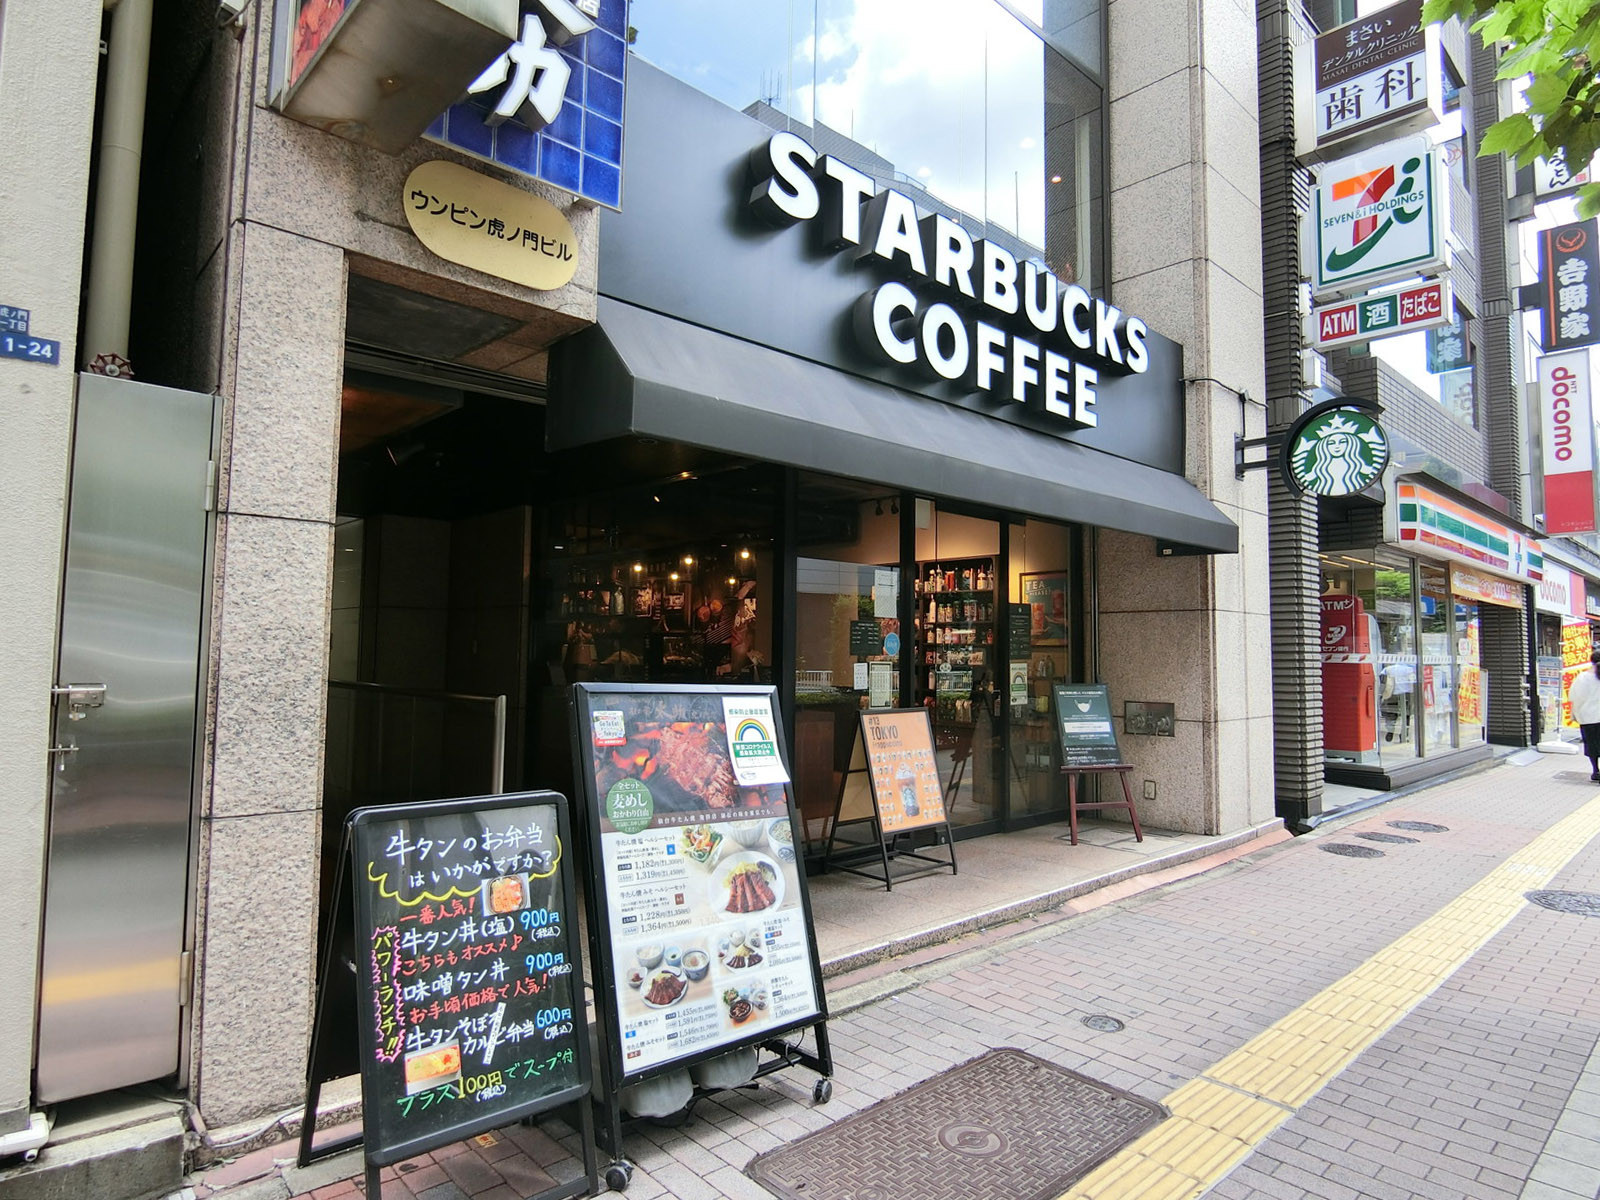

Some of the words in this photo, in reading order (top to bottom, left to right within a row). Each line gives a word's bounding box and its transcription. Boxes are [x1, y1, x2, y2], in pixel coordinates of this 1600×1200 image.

[1345, 20, 1392, 47] まさい
[1322, 25, 1418, 72] デンタルクリニック
[1322, 67, 1348, 82] MASAI
[1352, 53, 1383, 70] DENTAL
[1387, 40, 1418, 55] CLINIC
[1322, 61, 1421, 130] 歯科
[1369, 190, 1424, 216] HOLDINGS
[411, 190, 572, 262] ウンピン虎ノ門ビル
[768, 131, 1149, 374] STARBUCKS
[1401, 291, 1440, 320] たばこ
[1557, 258, 1590, 338] 吉野家
[0, 307, 28, 320] 虎ノ門
[1322, 309, 1354, 337] ATM
[1366, 301, 1390, 328] 酒
[5, 337, 53, 358] 1-24
[872, 281, 1098, 427] COFFEE
[1551, 367, 1576, 461] docomo
[1026, 581, 1045, 590] TEA
[870, 725, 899, 740] TOKYO
[612, 792, 648, 809] 麦めし
[612, 809, 650, 818] おかわり自由
[386, 823, 543, 866] 牛タンのお弁当
[400, 897, 475, 925] 一番人気!
[520, 908, 560, 930] 900円
[525, 952, 564, 975] 900円
[535, 1007, 572, 1029] 600円
